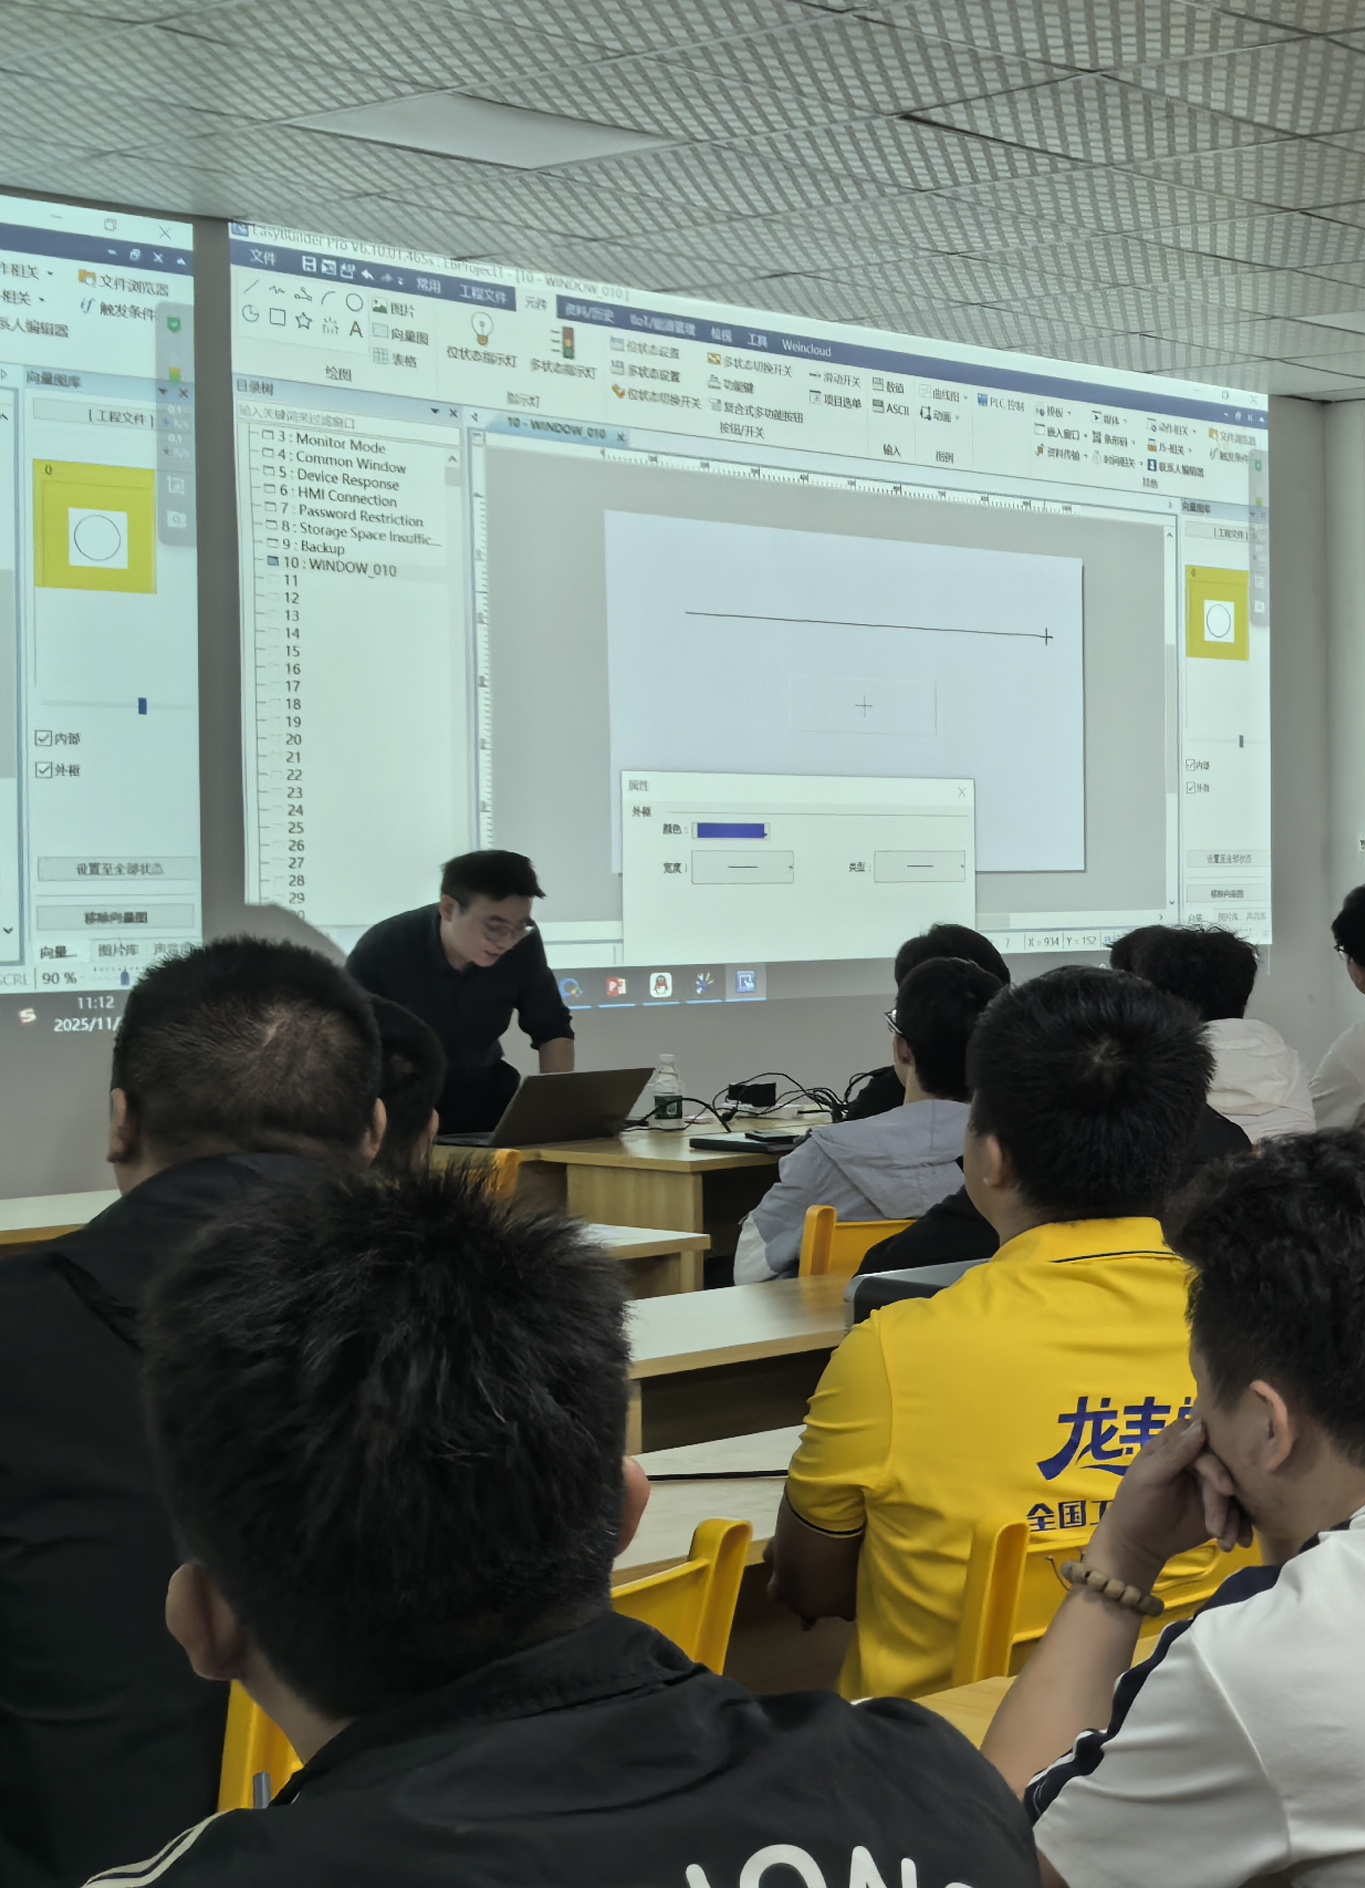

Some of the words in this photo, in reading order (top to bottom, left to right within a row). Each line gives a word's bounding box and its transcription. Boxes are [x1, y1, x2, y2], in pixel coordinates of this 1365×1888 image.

[250, 248, 277, 266] 文件
[100, 274, 169, 297] 文件浏览器
[416, 277, 441, 294] 常用
[460, 284, 508, 304] 工程文件
[390, 301, 415, 318] 图片
[391, 328, 429, 346] 向量图
[747, 332, 768, 348] 工具
[782, 337, 832, 357] Weincloud
[26, 370, 82, 389] 向量图库
[236, 379, 274, 396] 目录树
[989, 397, 1006, 410] PLC
[238, 403, 355, 430] 输入关键词来过滤窗口
[531, 419, 606, 440] WINDOW_010
[719, 421, 765, 440] 按钮/开关
[278, 431, 286, 443] 3
[296, 432, 346, 450] Monitor
[350, 439, 387, 454] Mode
[883, 443, 901, 457] 输入
[278, 449, 286, 460] 4
[296, 450, 354, 469] Common
[356, 459, 407, 475] Window
[279, 467, 287, 478] 5
[297, 468, 339, 484] Device
[342, 473, 400, 494] Response
[280, 485, 288, 496] 6
[298, 486, 325, 501] HMI
[328, 490, 398, 508] Connection
[281, 502, 288, 514] 7
[299, 504, 356, 521] Password
[360, 510, 424, 527] Restriction
[281, 520, 290, 532] 8
[300, 522, 348, 540] Storage
[350, 527, 386, 544] Space
[282, 539, 290, 550] 9
[301, 540, 345, 556] Backup
[284, 557, 299, 569] 10
[309, 557, 397, 579] WINDOW_010
[284, 575, 298, 587] 11
[284, 592, 300, 604] 12
[284, 610, 300, 622] 13
[284, 627, 301, 639] 14
[285, 645, 301, 657] 15
[285, 663, 301, 675] 16
[285, 680, 301, 692] 17
[286, 698, 302, 710] 18
[286, 716, 302, 728] 19
[55, 732, 81, 746] 内部
[286, 733, 302, 745] 20
[286, 751, 303, 763] 21
[55, 763, 81, 777] 外框
[287, 769, 303, 781] 22
[287, 786, 303, 798] 23
[287, 804, 303, 816] 24
[287, 822, 304, 834] 25
[288, 840, 304, 852] 26
[288, 857, 304, 869] 27
[288, 875, 304, 887] 28
[288, 892, 305, 904] 29
[1082, 935, 1097, 946] 152
[42, 972, 60, 984] 90
[64, 971, 77, 985] %
[77, 996, 115, 1009] 11:12
[1036, 1395, 1194, 1481] 龙丰
